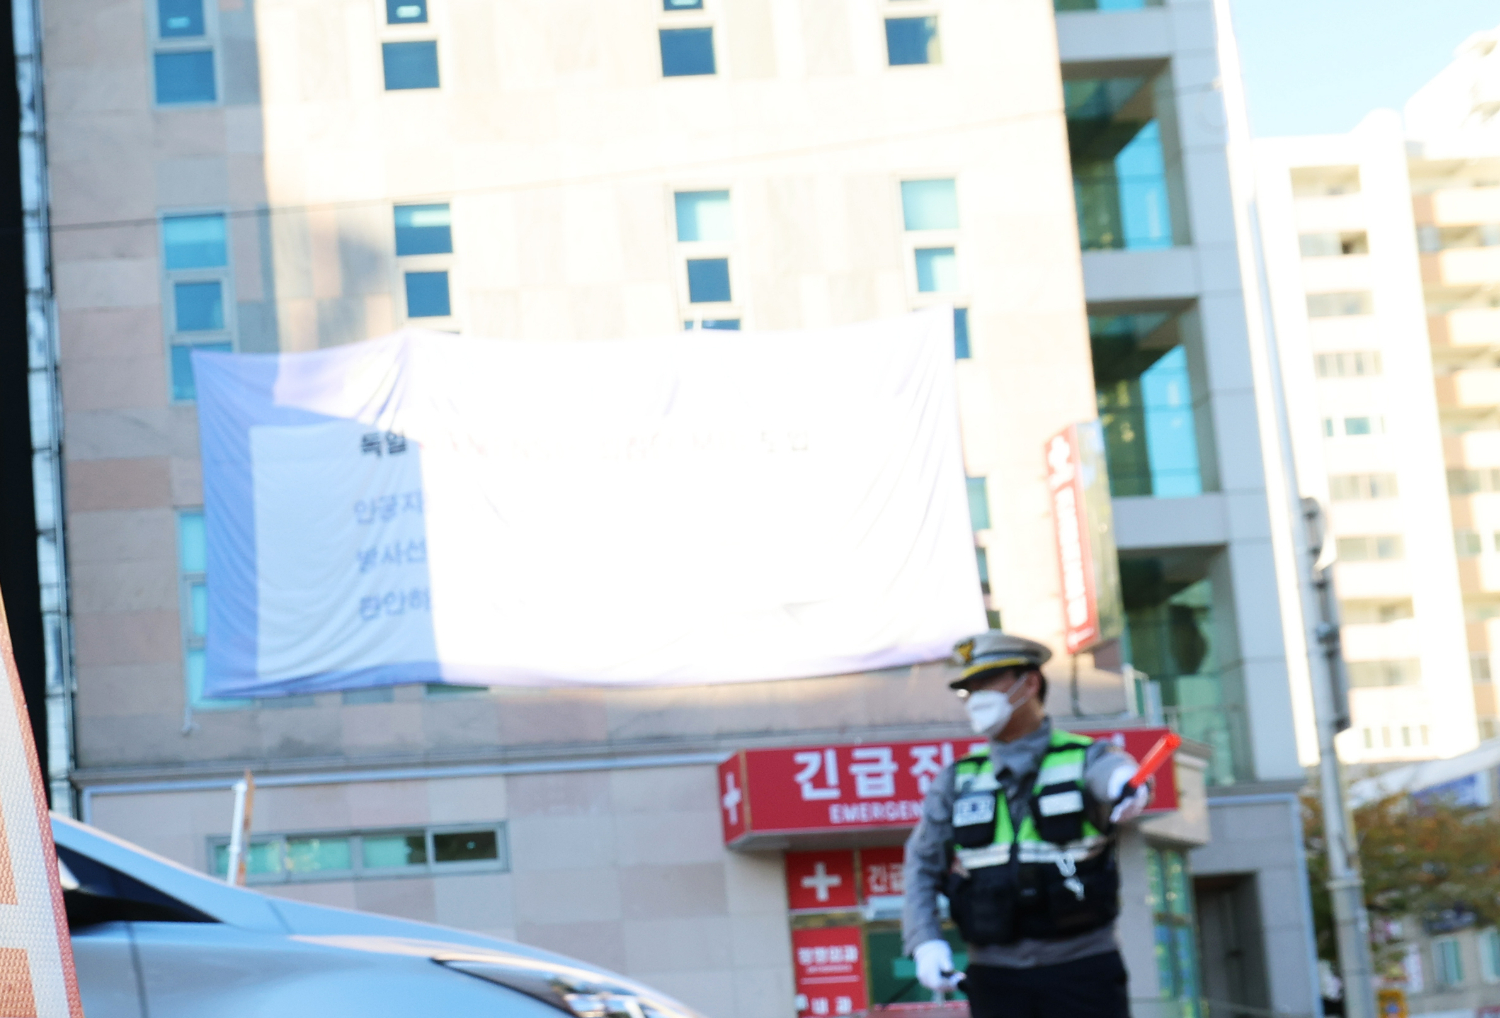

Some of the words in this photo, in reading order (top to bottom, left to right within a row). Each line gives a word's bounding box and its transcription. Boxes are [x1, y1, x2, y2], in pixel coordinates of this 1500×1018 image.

[361, 431, 408, 457] 독일
[353, 490, 423, 525] 인공지
[793, 742, 991, 801] 긴급진
[829, 799, 924, 824] EMERGEN
